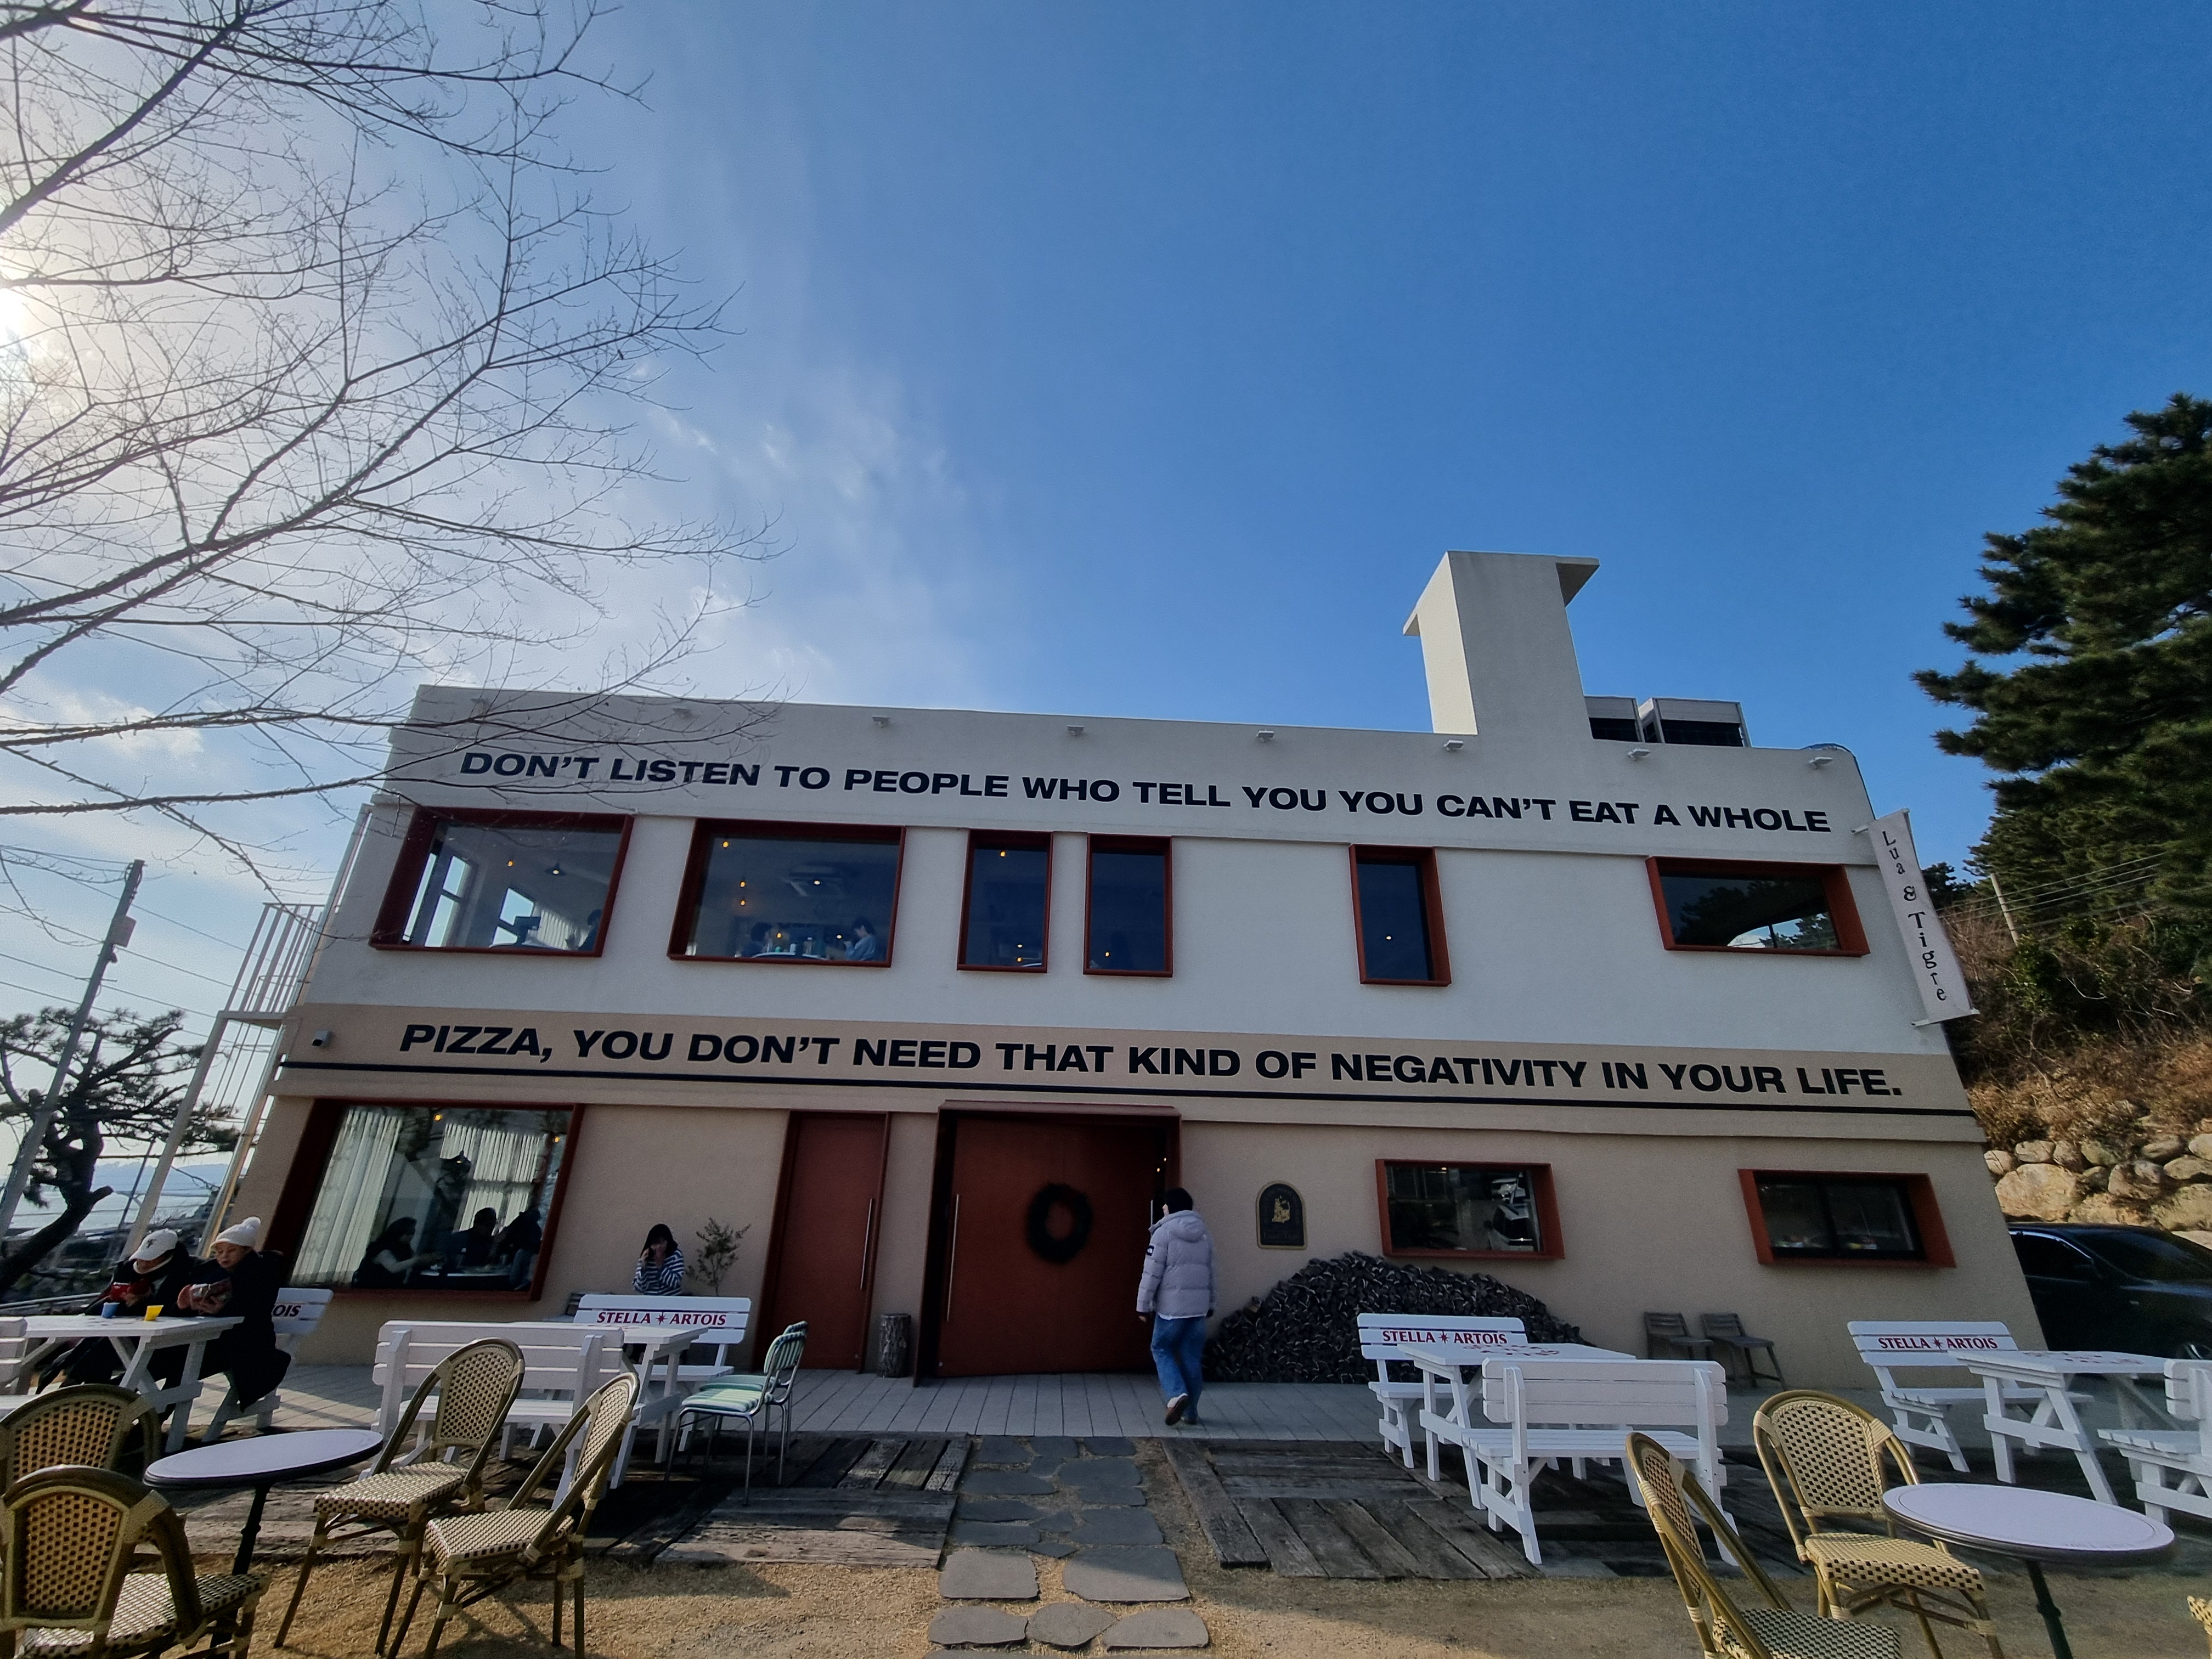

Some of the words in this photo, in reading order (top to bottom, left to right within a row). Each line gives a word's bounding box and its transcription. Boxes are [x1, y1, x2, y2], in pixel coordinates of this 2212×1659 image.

[460, 752, 600, 779] DON'T
[610, 758, 760, 786] LISTEN
[774, 765, 830, 789] TO
[844, 769, 1009, 797] PEOPLE
[1022, 777, 1120, 802] WHO
[1132, 781, 1231, 807] TELL
[1241, 786, 1327, 811] YOU
[1338, 790, 1423, 815] YOU
[1436, 794, 1556, 820] CAN'T
[1568, 800, 1640, 824] EAT
[1654, 804, 1681, 826] A
[1687, 805, 1831, 833] WHOLE
[1882, 831, 1905, 875] Lua
[1903, 885, 1916, 901] &
[1908, 911, 1947, 1001] Tigre
[399, 1024, 552, 1064] PIZZA,
[573, 1030, 674, 1060] YOU
[687, 1034, 840, 1064] DON'T
[853, 1039, 981, 1069] NEED
[995, 1043, 1114, 1073] THAT
[1129, 1047, 1240, 1076] KIND
[1255, 1051, 1316, 1079] OF
[1331, 1053, 1587, 1087] NEGATIVITY
[1601, 1062, 1649, 1090] IN
[1657, 1063, 1787, 1093] YOUR
[1796, 1068, 1902, 1096] LIFE.
[273, 1305, 301, 1317] OIS
[596, 1312, 651, 1324] STELLA
[669, 1313, 726, 1325] ARTOIS
[1383, 1330, 1436, 1343] STELLA
[1454, 1332, 1508, 1344] ARTOIS
[1877, 1338, 1931, 1349] STELLA
[1946, 1338, 1999, 1349] ARTOIS
